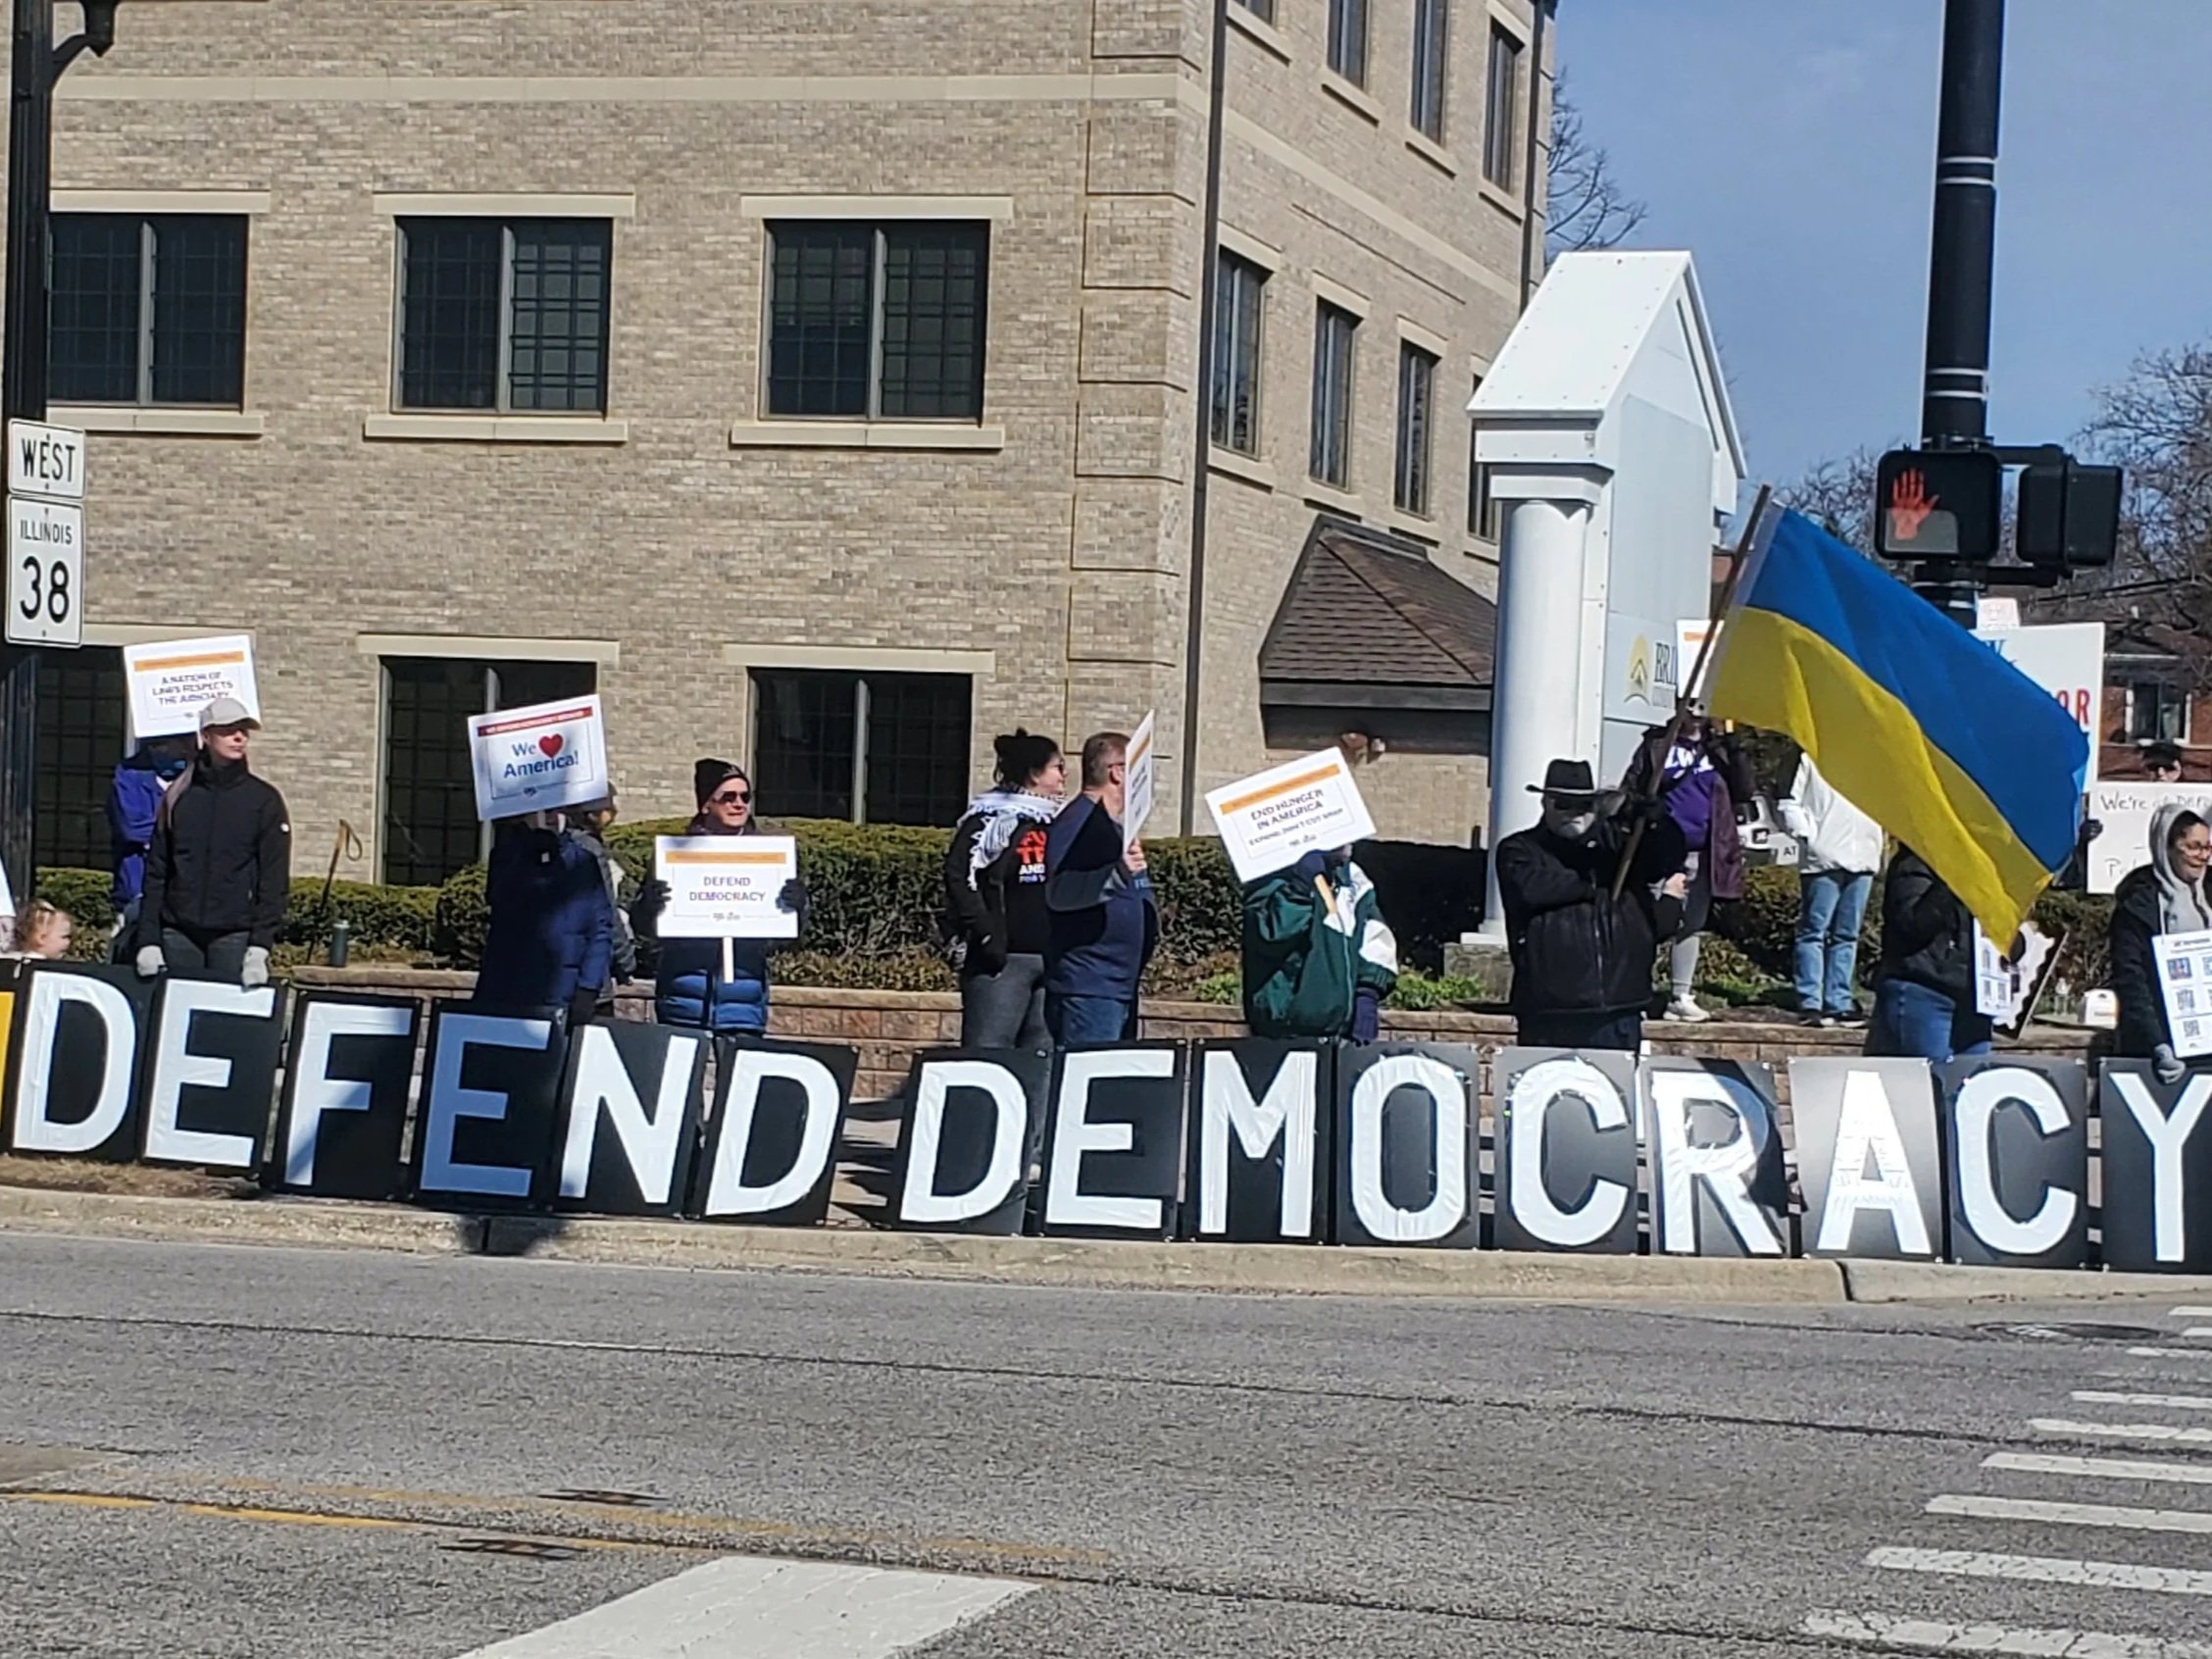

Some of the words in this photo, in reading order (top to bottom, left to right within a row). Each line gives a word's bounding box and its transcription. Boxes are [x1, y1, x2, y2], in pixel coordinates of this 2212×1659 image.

[22, 438, 75, 482] WEST
[20, 520, 73, 544] ILLINOIS
[20, 555, 70, 624] 38
[511, 741, 536, 758] We
[503, 750, 579, 779] America!
[1250, 806, 1275, 821] END
[1276, 788, 1324, 811] HUNGER
[1257, 820, 1270, 830] IN
[1271, 800, 1324, 825] AMERICA
[2100, 790, 2148, 811] We're
[703, 876, 751, 887] DEFEND
[689, 891, 767, 902] DEMOCRACY
[12, 970, 841, 1216] DEFEND
[900, 1049, 2212, 1262] DEMOCRACY
